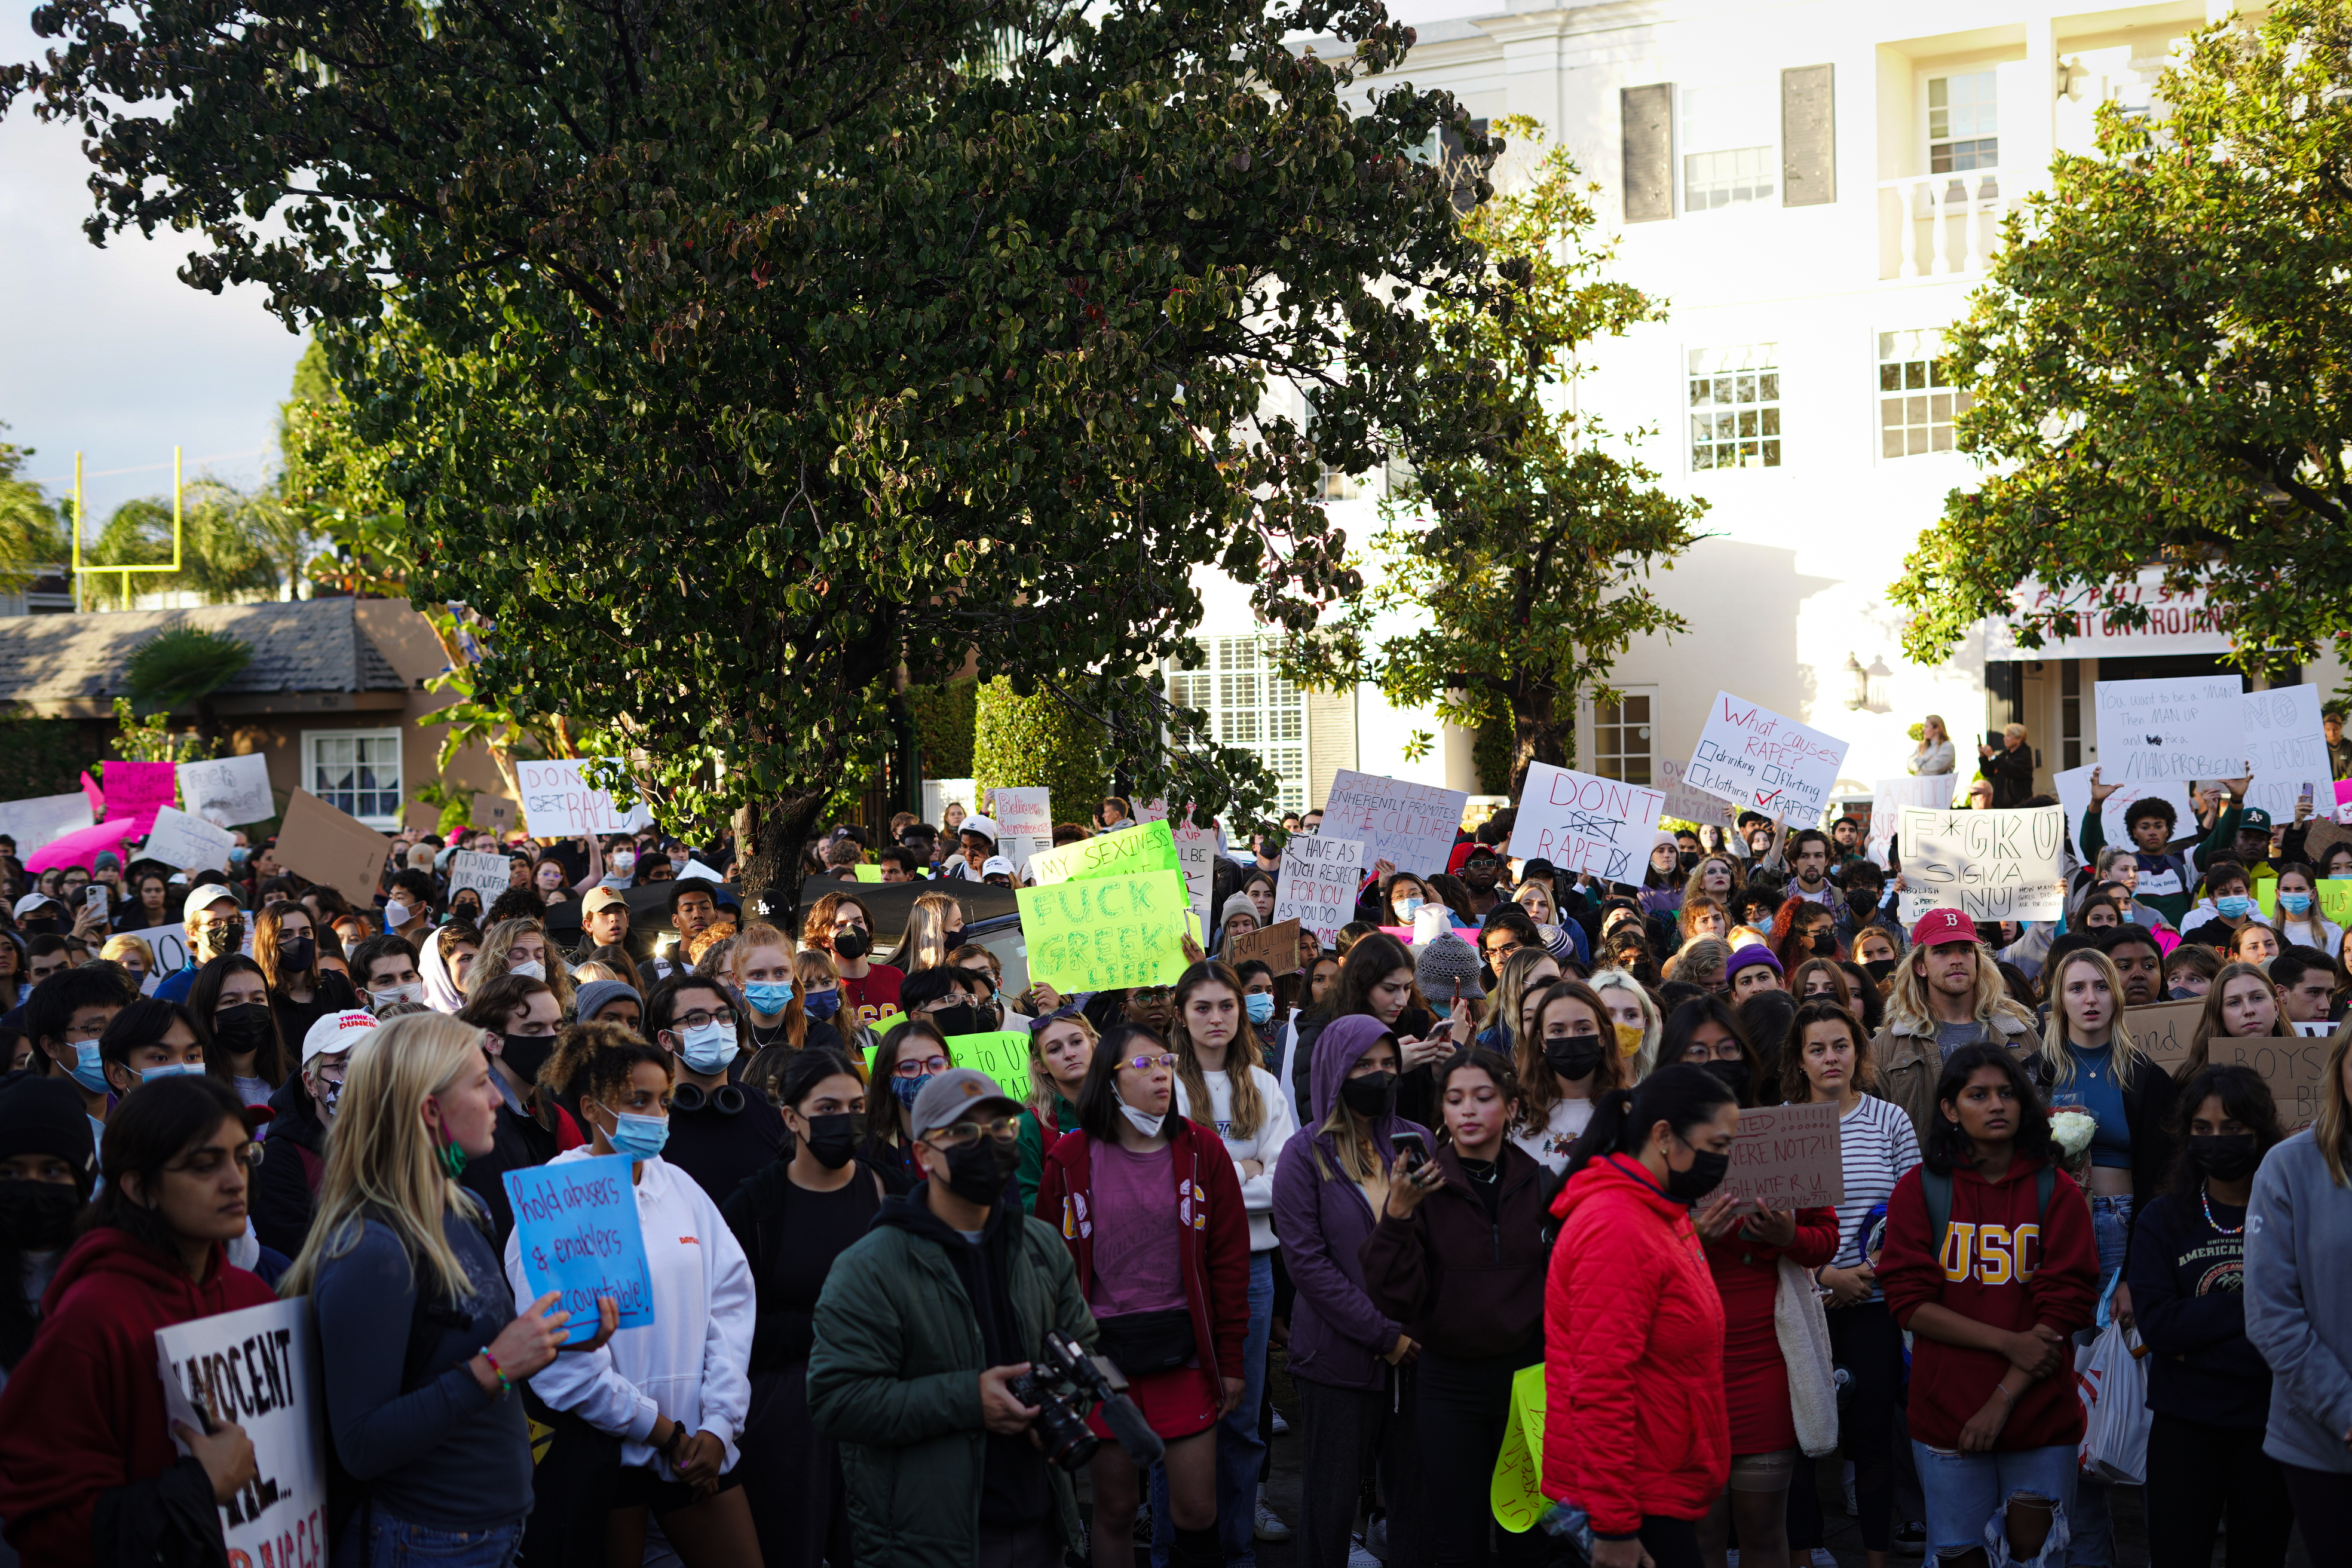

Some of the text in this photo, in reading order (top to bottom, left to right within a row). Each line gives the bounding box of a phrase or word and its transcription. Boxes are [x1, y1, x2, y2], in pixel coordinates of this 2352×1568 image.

[2096, 682, 2126, 709] You
[2130, 694, 2155, 706] want
[2161, 692, 2169, 703] to
[2173, 691, 2187, 702] be
[2191, 693, 2199, 702] a
[1725, 697, 1839, 765] What causes
[2120, 708, 2198, 727] Then MAN UP
[1744, 736, 1803, 769] RAPE?
[2123, 731, 2188, 746] and fix a
[2271, 734, 2320, 770] NOT
[1716, 749, 1755, 776] drinking
[2170, 753, 2244, 776] PROBLEM
[1336, 770, 1451, 806] GREEK LIFE
[1550, 773, 1664, 824] DON'T
[1706, 774, 1748, 804] clothing
[1780, 771, 1820, 803] flirting
[529, 795, 564, 812] GET
[999, 793, 1042, 815] Believe
[1328, 789, 1456, 819] INHERENTLY PROMOTES
[1773, 795, 1821, 824] RAPISTS
[999, 816, 1051, 835] Survivors
[1322, 801, 1457, 843] RAPE CULTURE
[1571, 811, 1626, 843] GET
[2032, 811, 2059, 860] U
[1042, 828, 1169, 882] MY SEXINESS
[1306, 838, 1336, 861] HAVE
[1336, 843, 1355, 862] AS
[1376, 830, 1425, 853] WON'T
[454, 871, 473, 885] OUR
[477, 856, 504, 872] NOT
[1284, 860, 1361, 886] MUCH RESPECT
[1923, 862, 2025, 886] SIGMA
[602, 887, 612, 896] SC
[1033, 880, 1157, 926] FUCK
[1290, 880, 1343, 905] FOR YOU
[1900, 886, 1940, 895] ABOLISH
[1913, 898, 1939, 906] GREEK
[1961, 886, 2013, 919] NU
[758, 899, 770, 915] LA
[1278, 902, 1293, 917] AS
[1300, 905, 1316, 920] YOU
[1319, 906, 1336, 923] DO
[1943, 914, 1958, 926] B
[1035, 923, 1166, 976] GREEK
[1233, 922, 1298, 958] FRAT CULTURE
[1088, 960, 1159, 989] LIFE!
[2132, 1019, 2183, 1054] and
[975, 1043, 996, 1073] to
[2235, 1047, 2323, 1080] BOYS
[1754, 1175, 1785, 1195] WTF
[1790, 1174, 1804, 1191] R
[1809, 1173, 1822, 1191] U
[512, 1175, 620, 1224] hold abusers
[553, 1223, 622, 1264] enablers
[1938, 1221, 2041, 1285] USC
